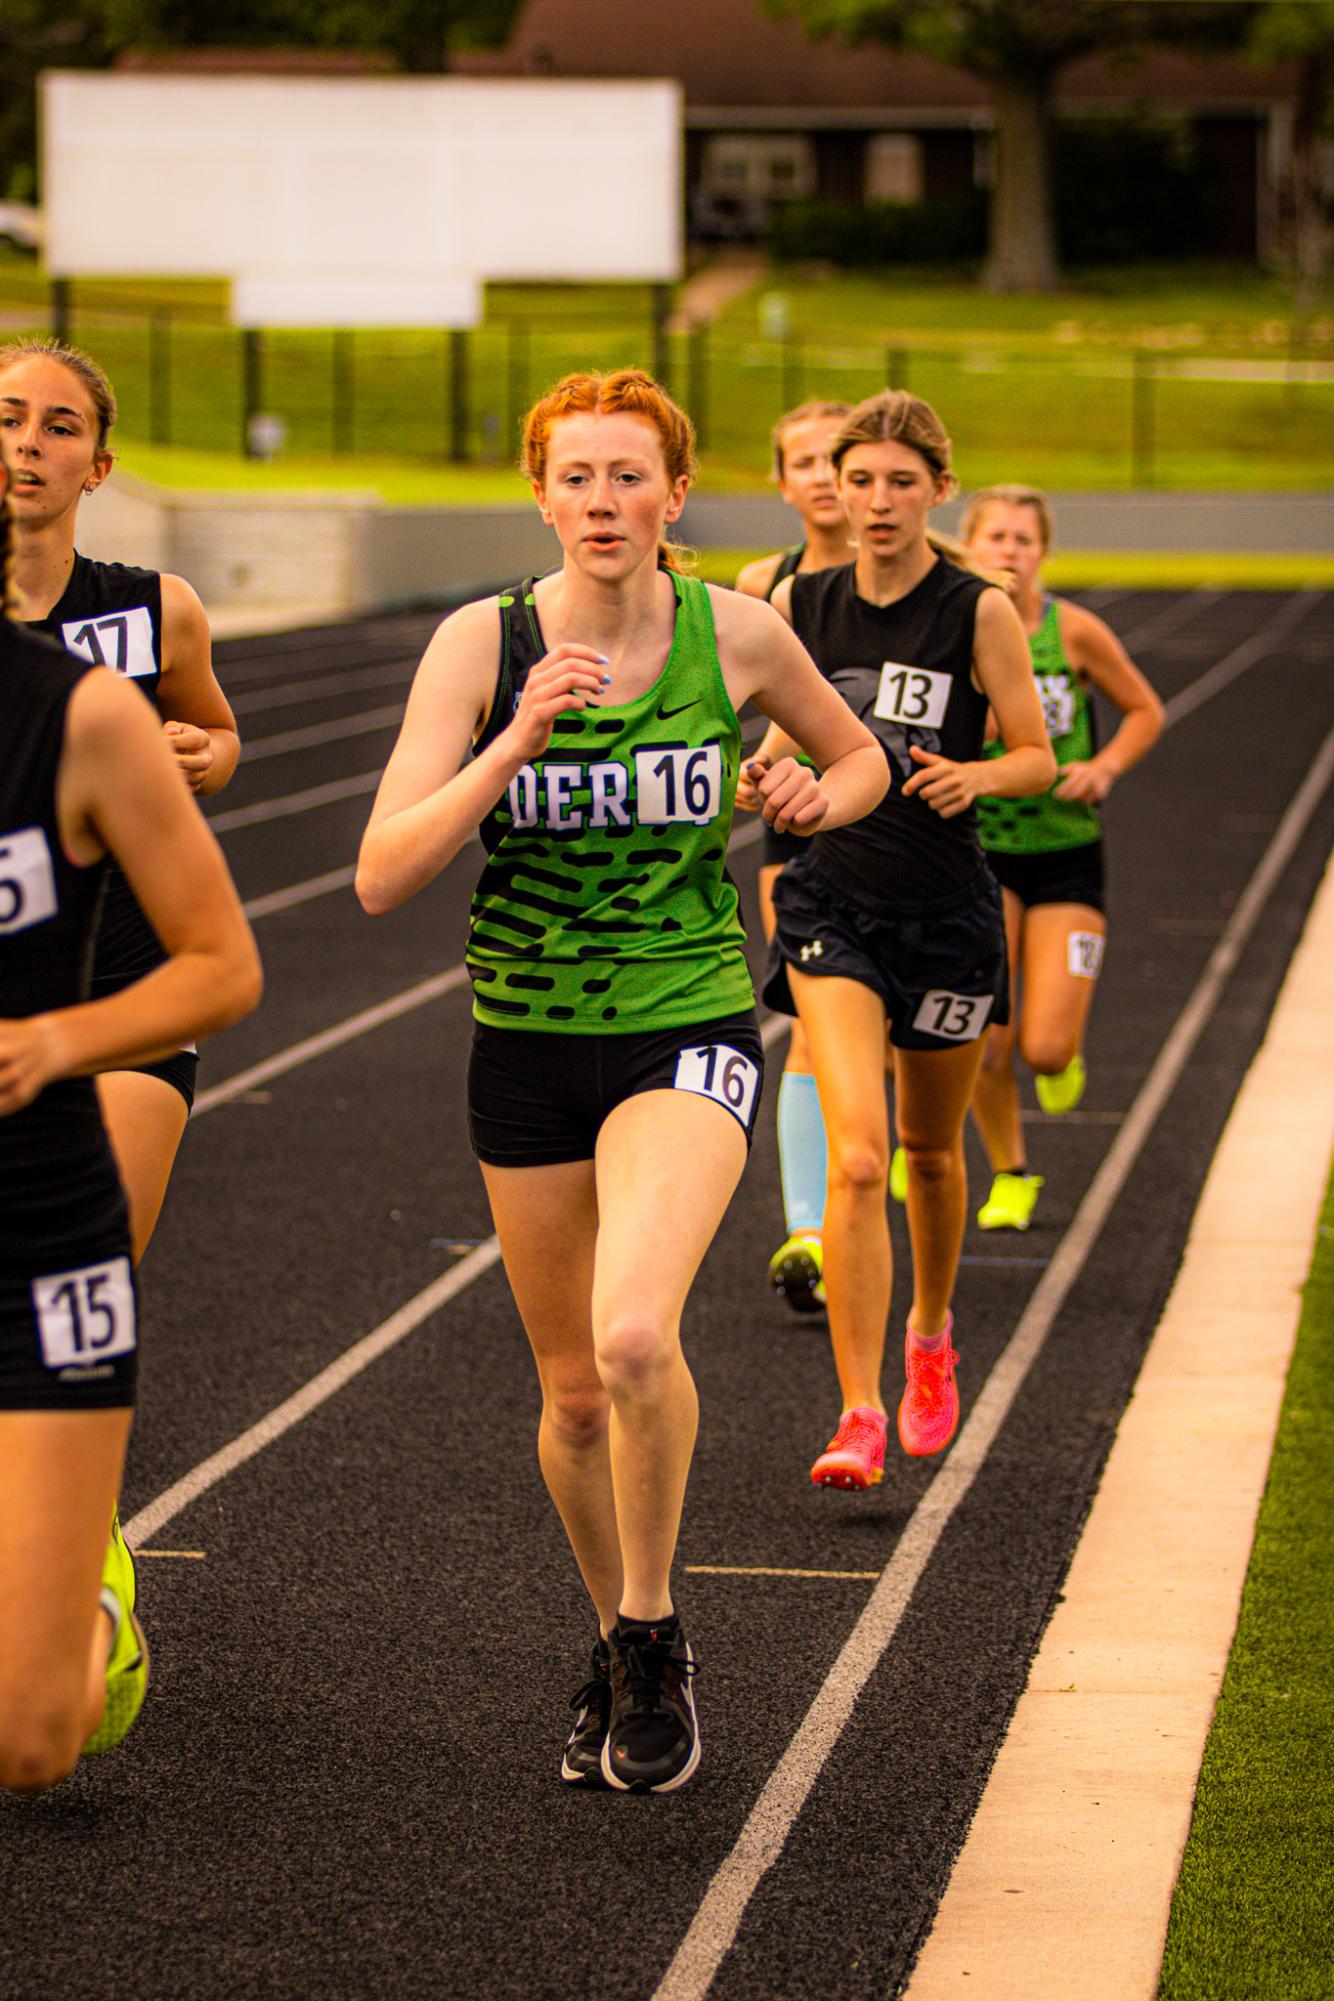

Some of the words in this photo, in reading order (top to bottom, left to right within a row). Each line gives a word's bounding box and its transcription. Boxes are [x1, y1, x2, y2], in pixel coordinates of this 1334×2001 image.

[73, 616, 128, 673] 17
[890, 670, 933, 720] 13
[653, 751, 711, 817] 16
[933, 996, 976, 1035] 13
[696, 1047, 748, 1108] 16
[51, 1274, 116, 1353] 15
